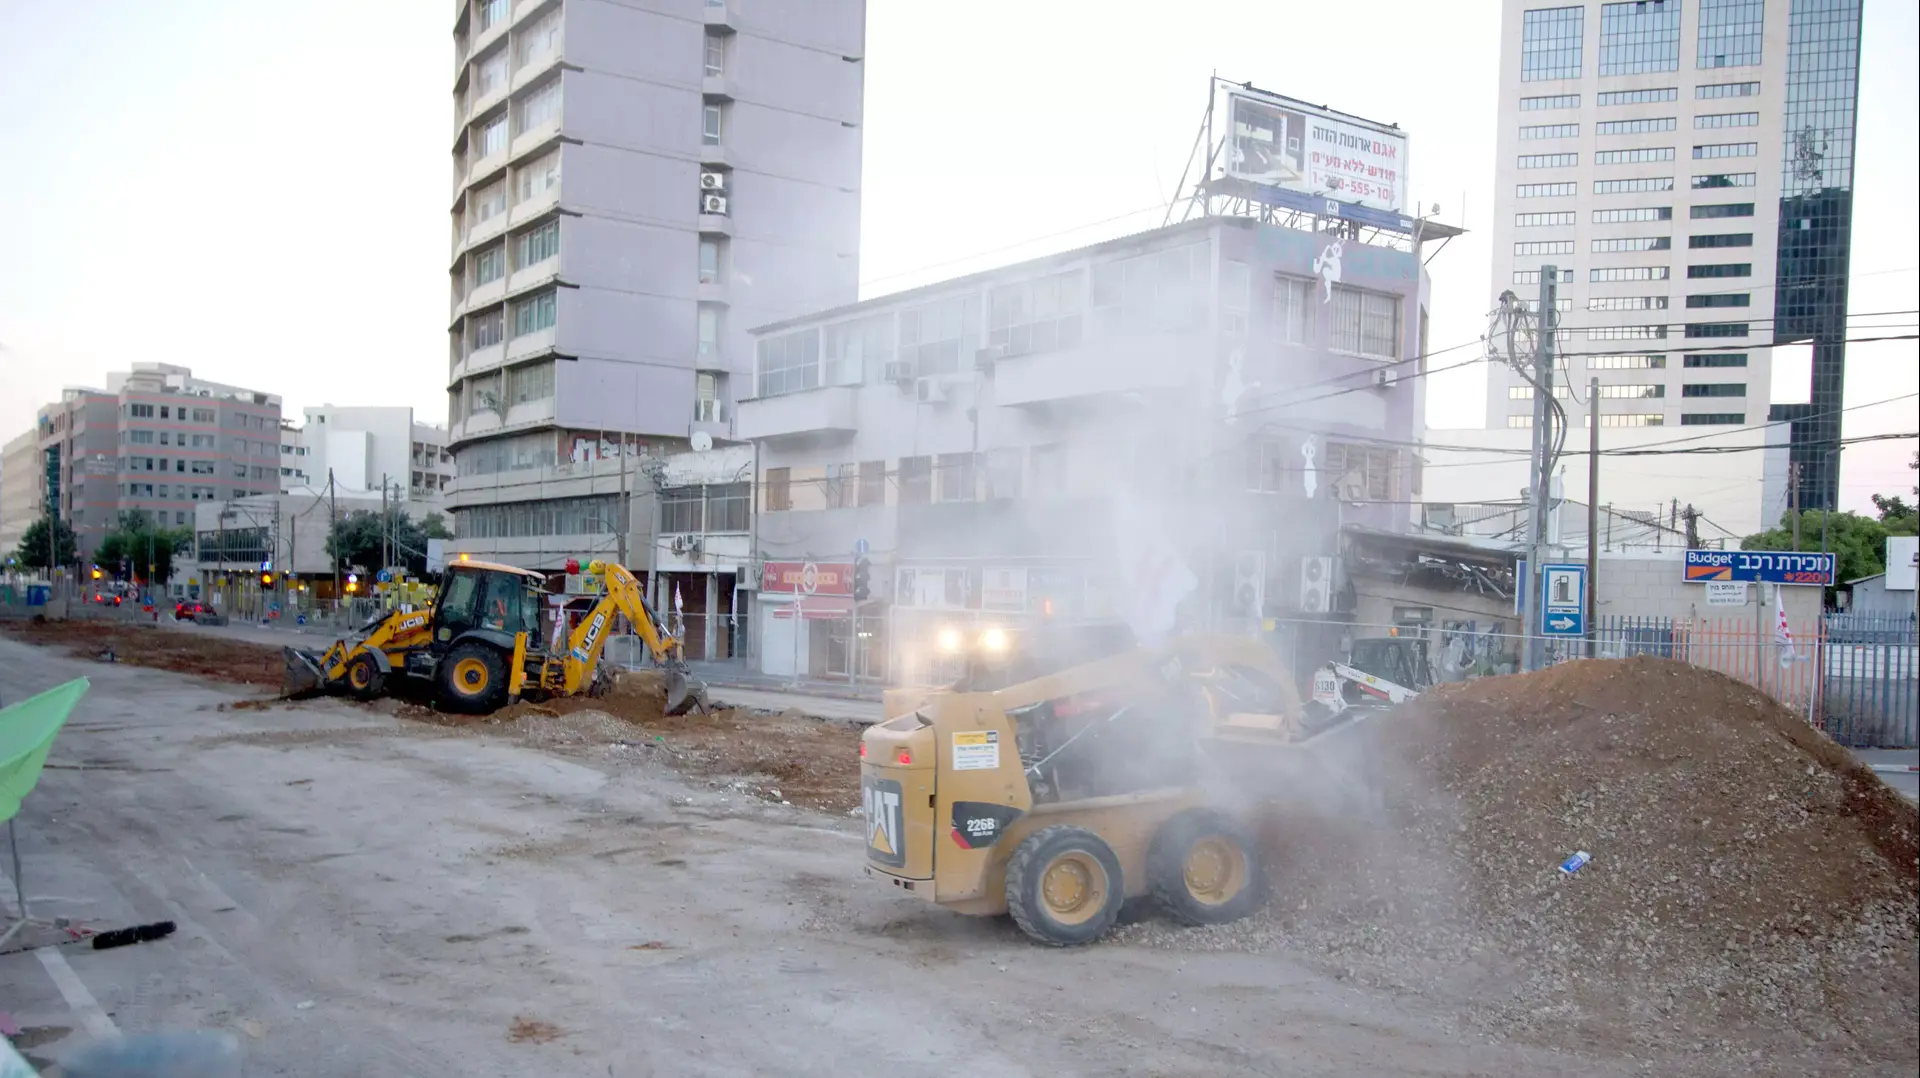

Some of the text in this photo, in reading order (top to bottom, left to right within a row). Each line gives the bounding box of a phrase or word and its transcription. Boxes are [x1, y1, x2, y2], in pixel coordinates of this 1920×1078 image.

[1373, 141, 1396, 158] אגם
[1688, 552, 1732, 566] Budget
[1738, 555, 1830, 571] מכירת רכב
[400, 616, 424, 630] JCB
[582, 613, 605, 650] JCB
[865, 786, 899, 856] CAT
[967, 817, 995, 831] 226B
